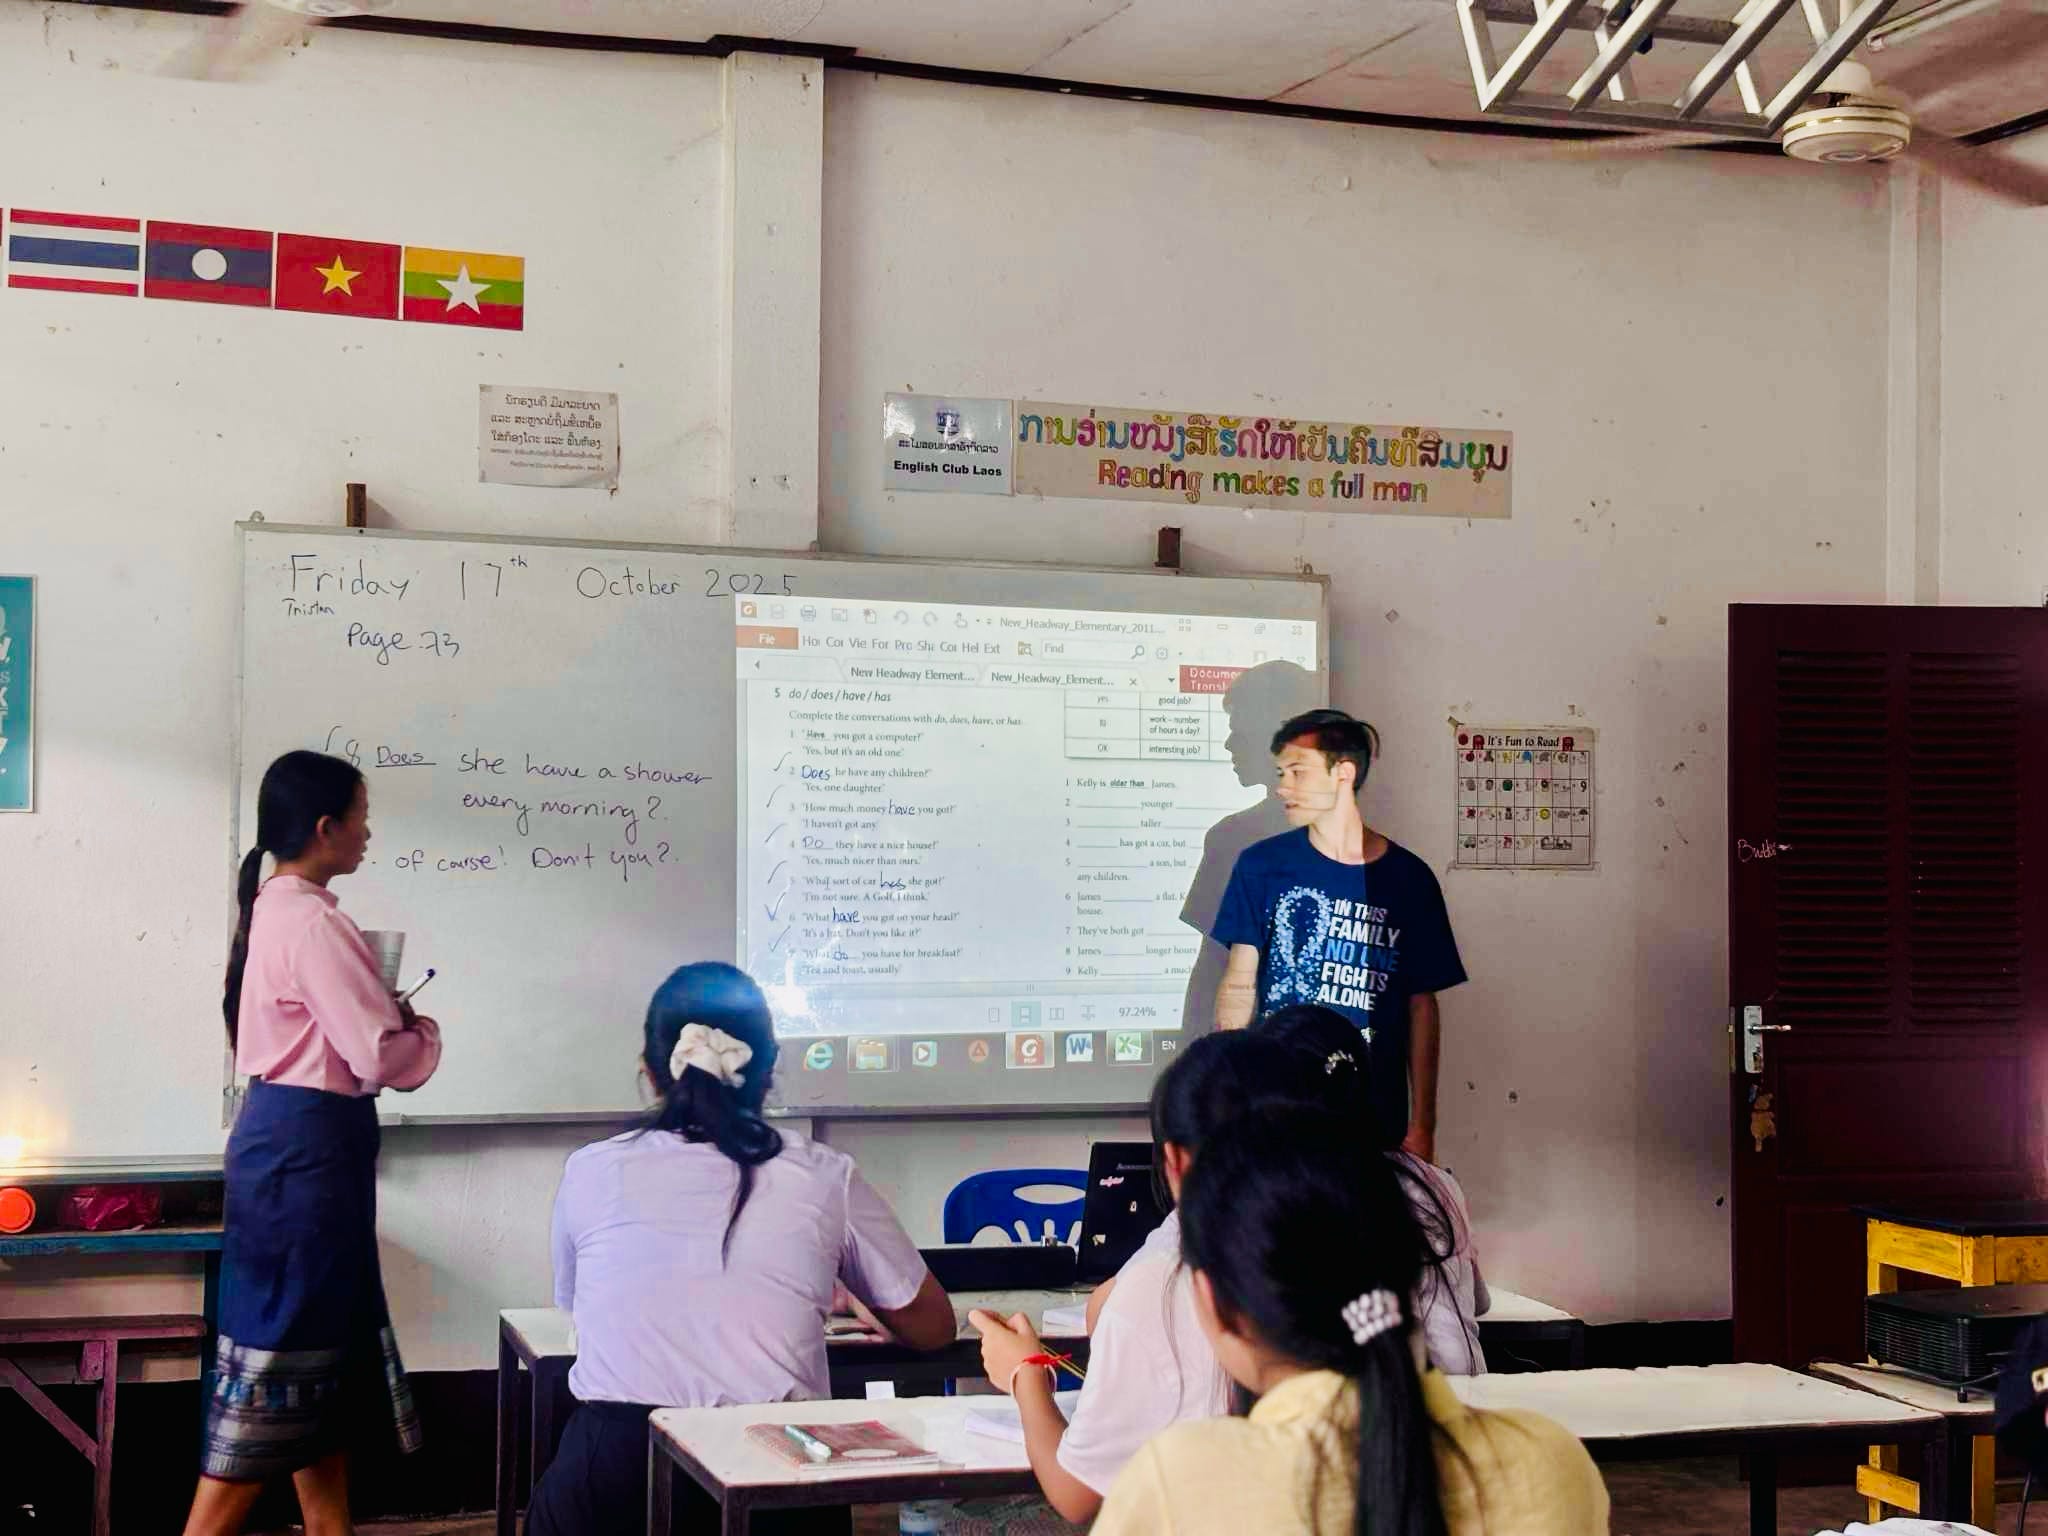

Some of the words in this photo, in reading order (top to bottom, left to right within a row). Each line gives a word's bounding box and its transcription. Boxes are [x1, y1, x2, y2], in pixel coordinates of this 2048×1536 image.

[894, 460, 938, 473] English
[942, 463, 969, 474] Club
[973, 465, 1002, 476] Laos
[1098, 459, 1203, 503] Reading
[1213, 470, 1300, 496] makes
[1308, 478, 1324, 497] a
[1330, 470, 1364, 499] full
[1372, 480, 1428, 502] man
[291, 555, 409, 600] Friday
[577, 567, 681, 598] October
[705, 568, 797, 597] 2025
[759, 633, 775, 645] File
[984, 643, 1000, 654] Ext
[1044, 643, 1064, 654] Find
[851, 667, 873, 677] New
[876, 668, 921, 680] Headway
[789, 688, 802, 699] do
[810, 689, 833, 700] does
[843, 690, 866, 701] have
[874, 691, 891, 702] has
[789, 710, 833, 721] Complete
[835, 712, 849, 721] the
[851, 712, 911, 722] conversations
[913, 714, 932, 724] with
[833, 733, 850, 742] you
[852, 733, 866, 742] got
[1488, 736, 1502, 746] It's
[1505, 736, 1521, 746] Fun
[1525, 737, 1534, 747] to
[1538, 736, 1560, 747] Read
[824, 746, 839, 756] but
[868, 748, 882, 756] old
[1149, 746, 1185, 755] interesting
[376, 746, 425, 765] Does
[459, 748, 505, 775] she
[526, 753, 586, 778] have
[598, 767, 616, 778] a
[625, 765, 712, 784] shower
[801, 764, 831, 781] Does
[848, 767, 869, 776] have
[870, 769, 886, 779] any
[1077, 779, 1097, 790] Kelly
[1099, 779, 1106, 787] is
[1110, 779, 1127, 788] older
[1130, 779, 1145, 788] than
[829, 803, 853, 812] much
[856, 805, 887, 815] money
[889, 799, 916, 816] have
[917, 806, 933, 815] you
[1140, 801, 1173, 809] younger
[463, 794, 530, 836] every
[845, 821, 859, 830] got
[1140, 819, 1162, 827] taller
[802, 836, 824, 849] Do
[835, 840, 854, 850] they
[1119, 839, 1134, 847] has
[1135, 839, 1148, 848] got
[1173, 839, 1186, 847] but
[395, 849, 424, 869] of
[532, 843, 595, 869] Don't
[824, 856, 850, 865] much
[853, 856, 874, 865] nicer
[877, 856, 897, 865] than
[1174, 859, 1186, 867] but
[1077, 874, 1091, 883] any
[1077, 893, 1101, 903] James
[832, 906, 861, 923] have
[910, 914, 930, 923] your
[1334, 899, 1352, 916] IN
[1355, 902, 1388, 923] THIS
[1110, 926, 1129, 935] both
[1131, 927, 1144, 936] got
[1329, 916, 1400, 948] FAMILY
[880, 950, 900, 958] have
[903, 950, 916, 958] for
[1077, 946, 1101, 956] James
[1146, 945, 1171, 955] longer
[1324, 939, 1354, 963] NO
[1078, 966, 1098, 976] Kelly
[1321, 962, 1388, 992] FIGHTS
[1316, 984, 1376, 1011] ALONE
[1119, 1007, 1156, 1017] 97.24%
[1162, 1041, 1176, 1050] EN
